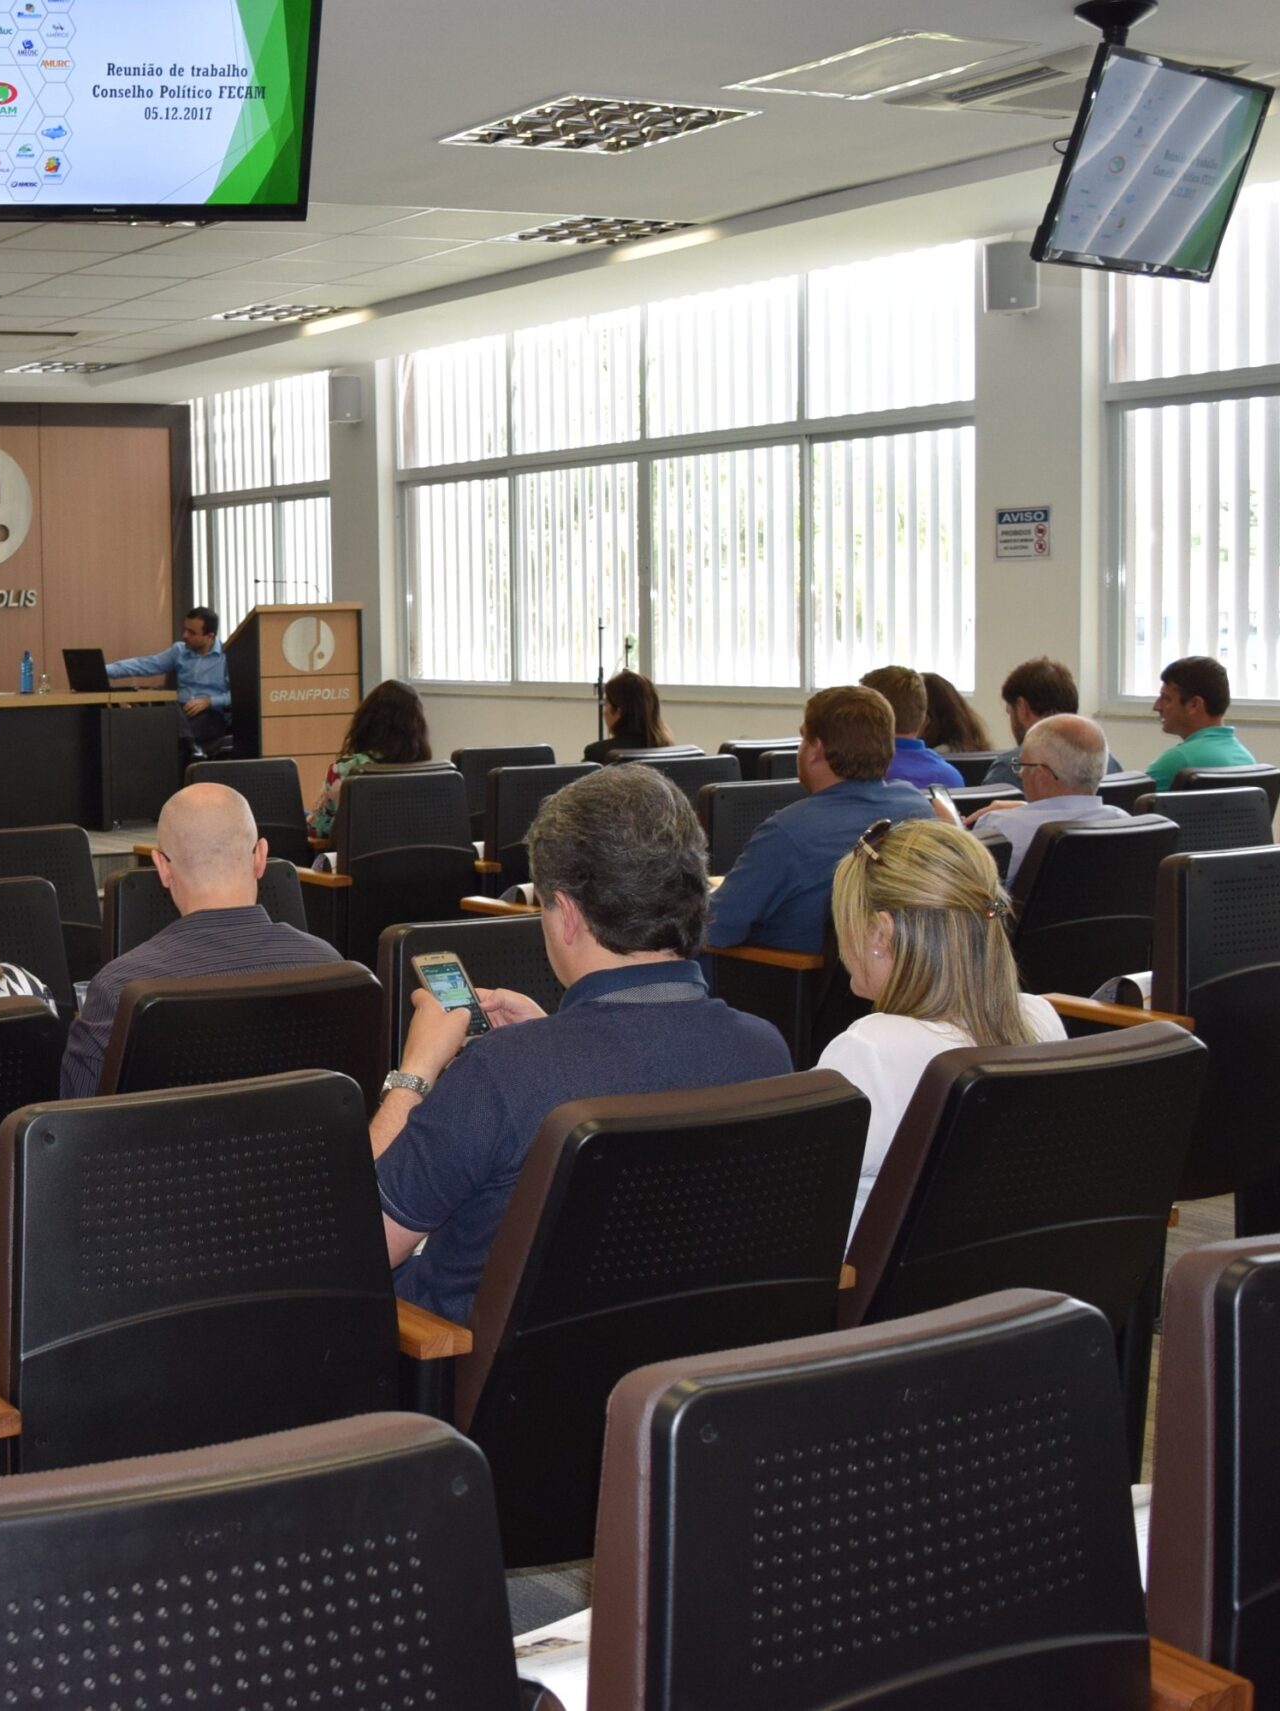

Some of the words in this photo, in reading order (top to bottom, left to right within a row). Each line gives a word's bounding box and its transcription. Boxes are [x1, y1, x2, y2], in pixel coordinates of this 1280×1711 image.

[106, 63, 163, 77] Reunião
[169, 63, 185, 77] de
[191, 64, 248, 78] trabalho
[92, 84, 154, 99] Conselho
[159, 84, 213, 99] Político
[218, 85, 267, 100] FECAM
[144, 106, 213, 120] 05.12.2017
[1001, 511, 1045, 522] AVISO
[269, 687, 350, 702] GRANFPOLIS
